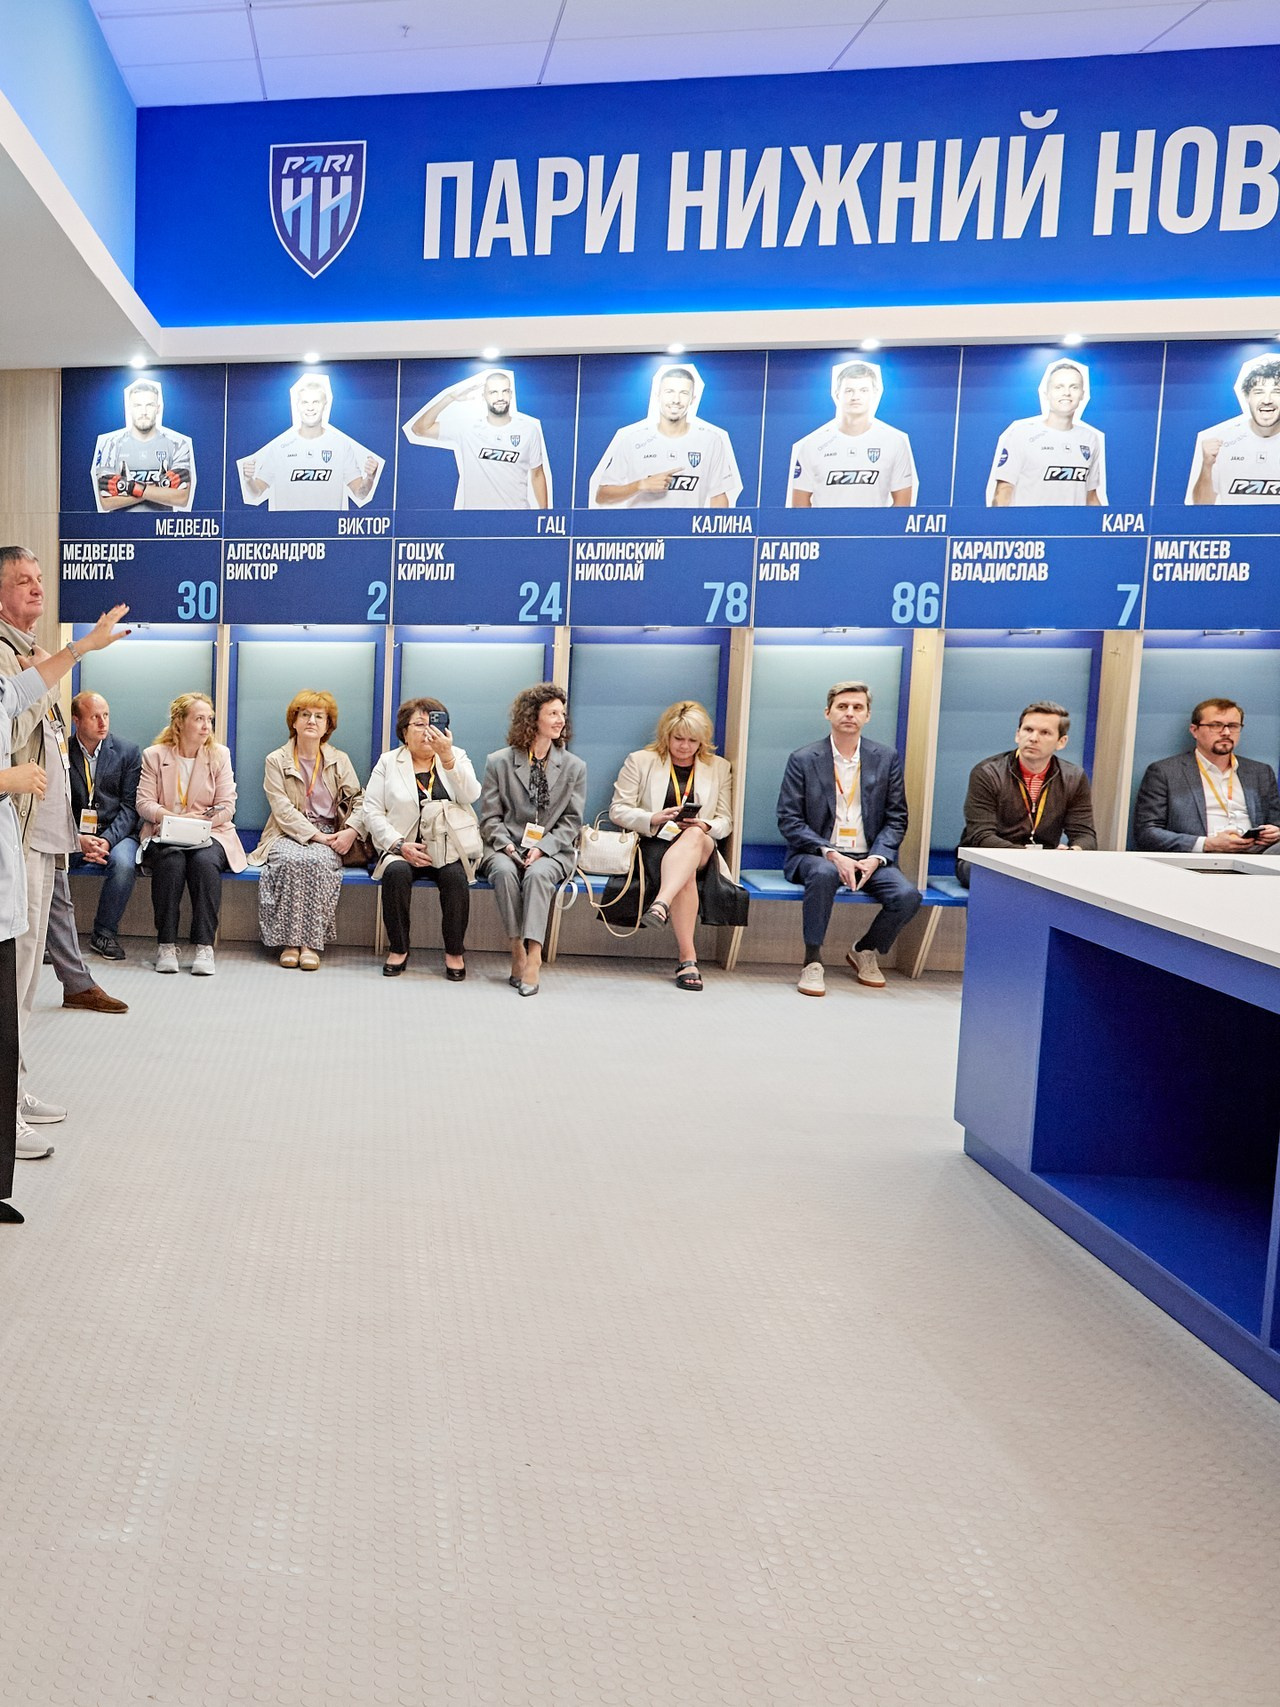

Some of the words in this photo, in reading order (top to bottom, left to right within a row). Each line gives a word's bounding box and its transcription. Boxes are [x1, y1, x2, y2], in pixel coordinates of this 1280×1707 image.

[281, 153, 354, 175] PARI
[423, 153, 640, 260] ПАРИ
[667, 108, 1065, 252] НИЖНИЙ
[1092, 123, 1280, 236] НОВ
[291, 470, 332, 481] PARI
[827, 471, 879, 485] PARI
[1230, 480, 1280, 494] PAR
[155, 518, 220, 537] МЕДВЕДЬ
[337, 517, 391, 535] ВИКТОР
[537, 515, 566, 536] ГАЦ
[691, 515, 753, 534] КАЛИНА
[905, 514, 947, 533] АГАП
[1102, 513, 1145, 532] КАРА
[63, 543, 135, 562] МЕДВЕДЕВ
[226, 543, 326, 561] АЛЕКСАНДРОВ
[398, 542, 445, 562] ГОЦУК
[576, 539, 665, 560] КАЛИНСКИЙ
[760, 542, 820, 560] АГАПОВ
[952, 541, 1045, 560] КАРАПУЗОВ
[1153, 540, 1231, 560] МАГКЕЕВ
[62, 563, 115, 580] НИКИТА
[226, 563, 278, 580] ВИКТОР
[397, 563, 455, 581] КИРИЛЛ
[575, 560, 645, 581] НИКОЛАЙ
[759, 563, 800, 581] ИЛЬЯ
[951, 563, 1049, 583] ВЛАДИСЛАВ
[1152, 562, 1250, 582] СТАНИСЛАВ
[177, 580, 218, 620] 30
[366, 580, 388, 621] 2
[518, 581, 562, 622] 24
[703, 581, 748, 623] 78
[891, 581, 940, 624] 86
[1116, 583, 1140, 626] 7
